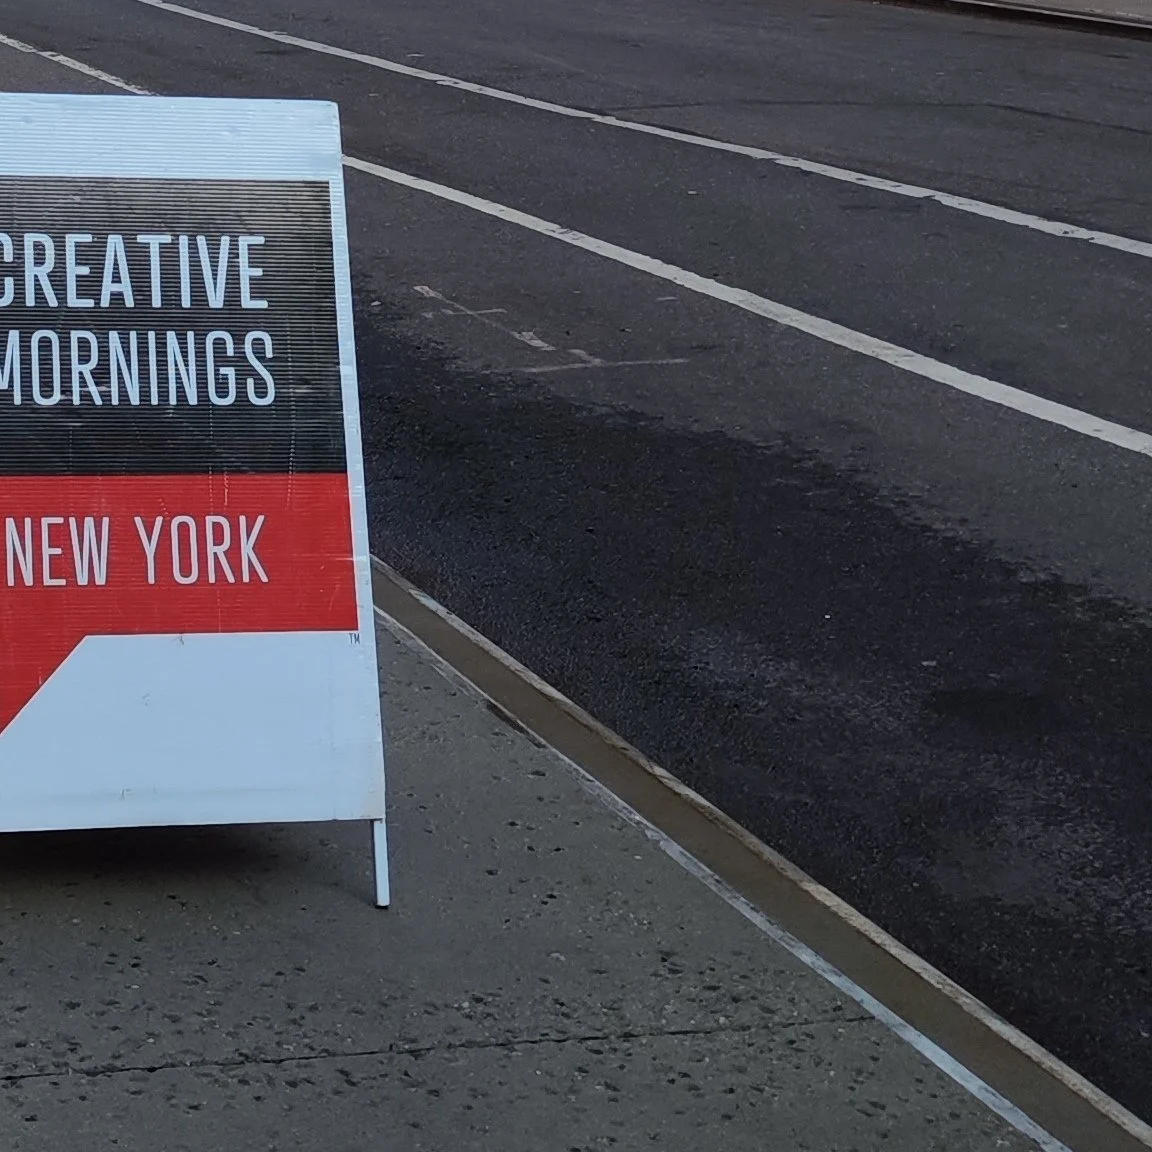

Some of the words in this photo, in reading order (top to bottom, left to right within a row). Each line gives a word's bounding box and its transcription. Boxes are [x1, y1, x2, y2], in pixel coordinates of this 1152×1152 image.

[5, 516, 111, 587] NEW
[134, 515, 269, 586] YORK
[349, 632, 361, 645] TM
